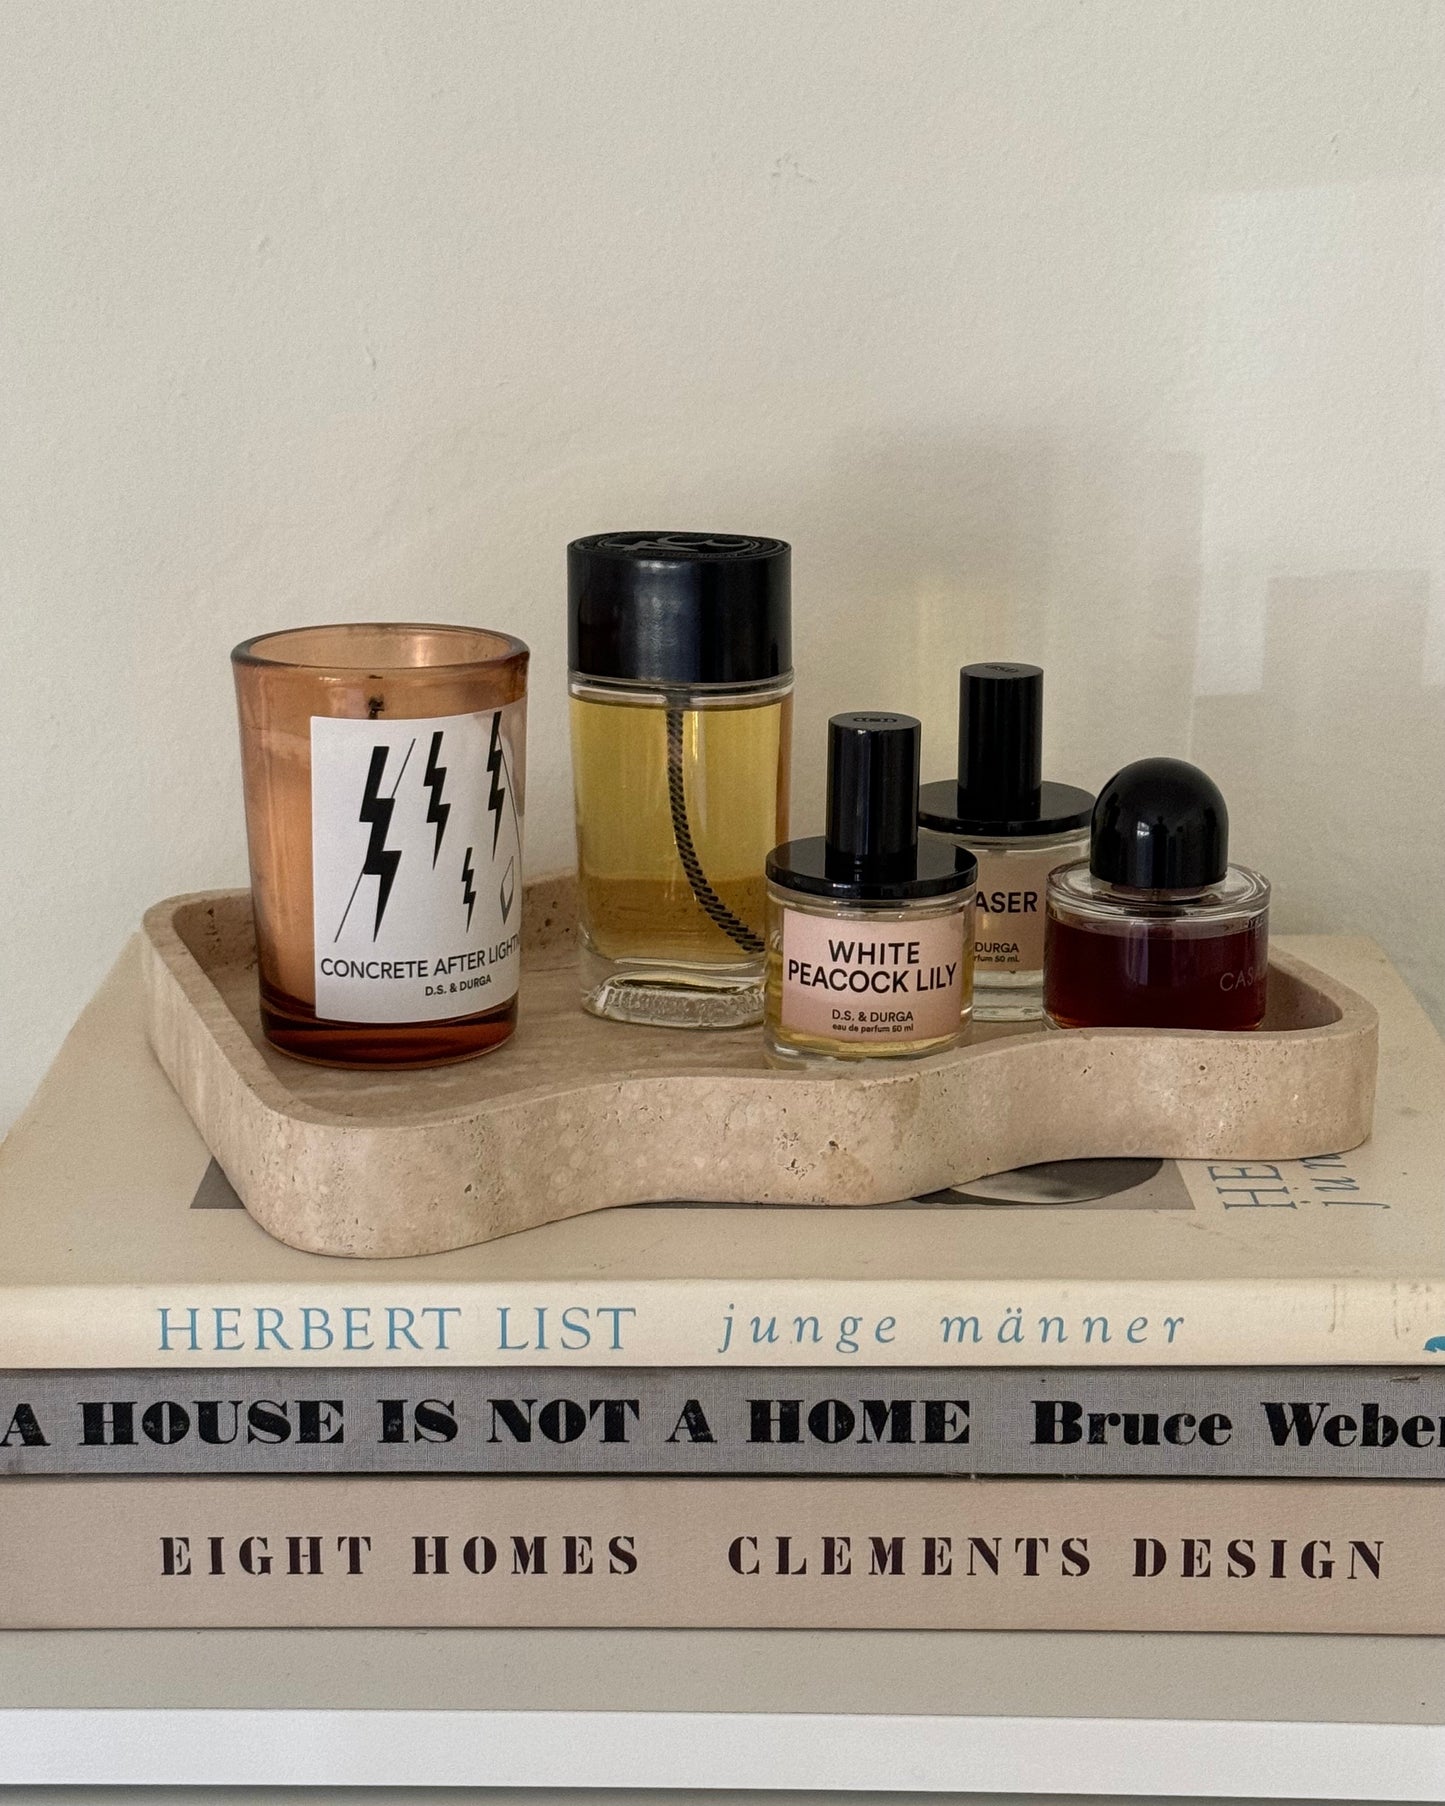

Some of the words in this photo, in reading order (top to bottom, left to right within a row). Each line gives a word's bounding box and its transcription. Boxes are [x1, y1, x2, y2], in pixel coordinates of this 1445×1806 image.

[975, 891, 1038, 913] ASER
[828, 939, 920, 965] WHITE
[972, 953, 993, 963] rfum
[974, 941, 1020, 953] DURGA
[320, 957, 428, 979] CONCRETE
[433, 950, 485, 976] AFTER
[788, 959, 909, 994] PEACOCK
[916, 962, 957, 992] LILY
[425, 985, 447, 997] D.S.
[449, 984, 457, 993] &
[459, 973, 492, 992] DURGA
[1220, 966, 1255, 992] CAS
[832, 1009, 855, 1021] D.S.
[858, 1012, 867, 1022] &
[870, 1011, 914, 1022] DURGA
[832, 1023, 847, 1032] eau
[848, 1024, 859, 1033] de
[860, 1025, 890, 1034] parfum
[1299, 1153, 1392, 1210] jun
[157, 1307, 462, 1351] HERBERT
[497, 1307, 637, 1351] LIST
[717, 1302, 897, 1354] junge
[942, 1306, 1186, 1345] männer
[0, 1402, 51, 1447] A
[77, 1399, 344, 1446] HOUSE
[377, 1399, 459, 1444] IS
[486, 1399, 640, 1445] NOT
[665, 1399, 718, 1445] A
[745, 1399, 970, 1446] HOME
[1029, 1400, 1233, 1447] Bruce
[1259, 1401, 1445, 1448] Webe
[159, 1536, 373, 1576] EIGHT
[412, 1535, 639, 1576] HOMES
[727, 1536, 1091, 1578] CLEMENTS
[1132, 1538, 1385, 1580] DESIGN
